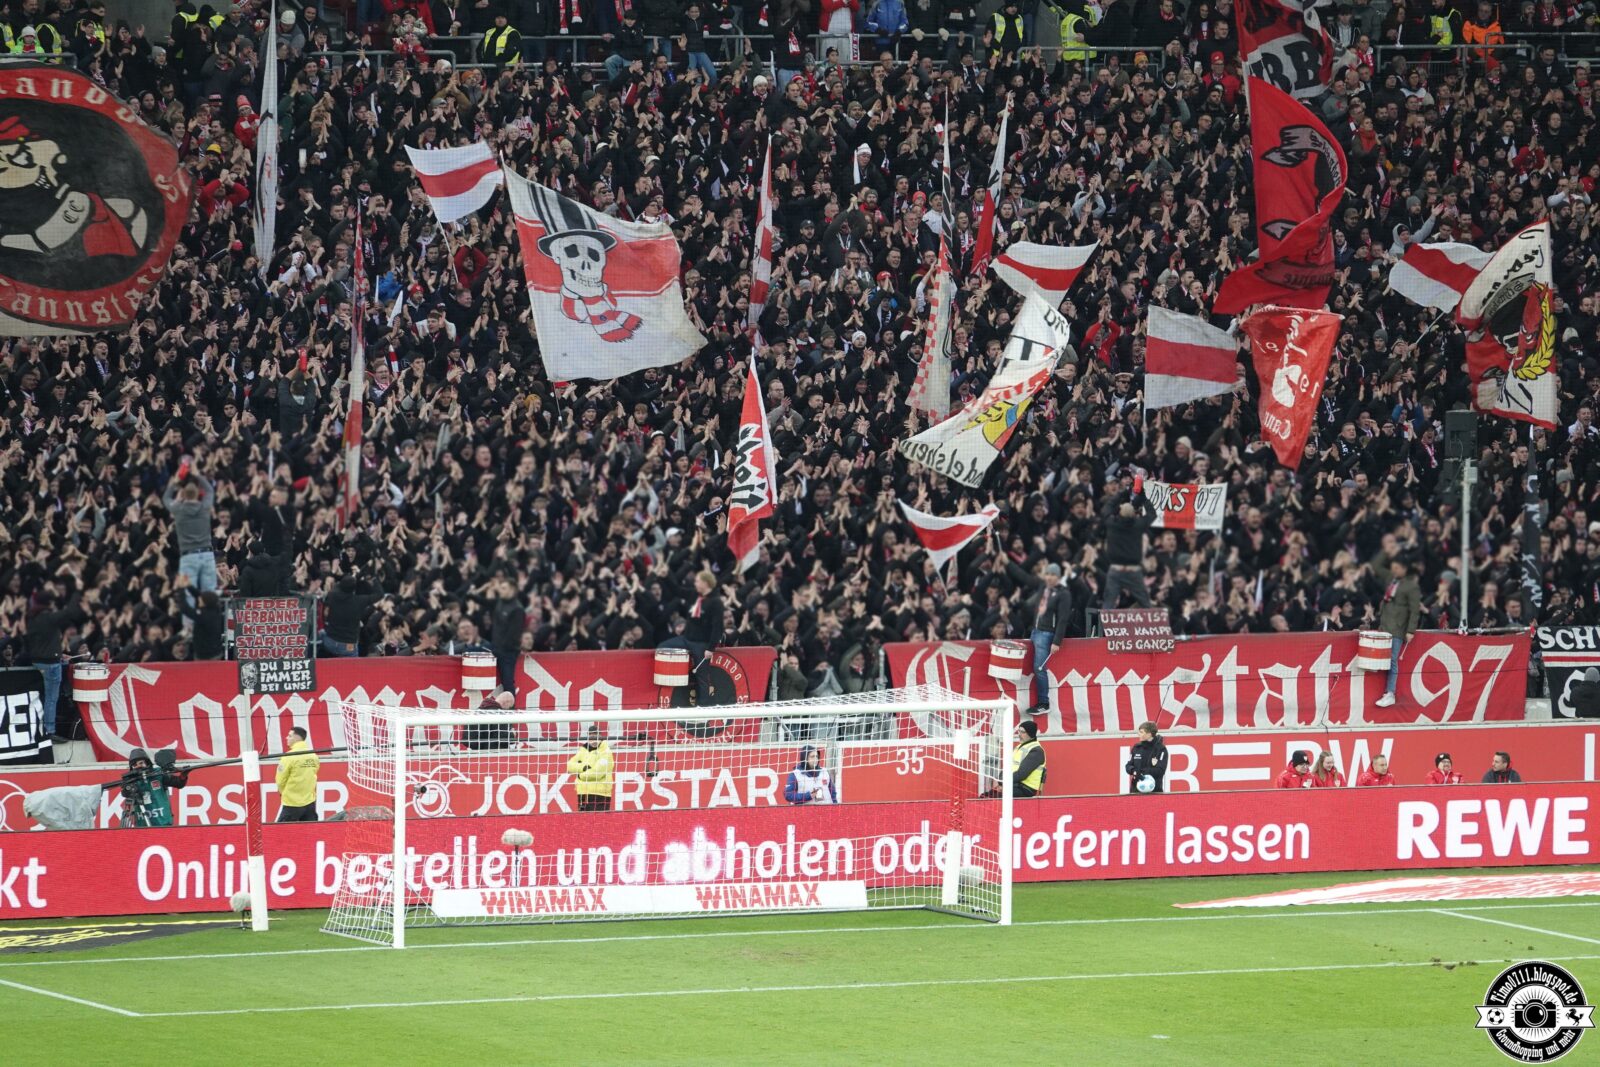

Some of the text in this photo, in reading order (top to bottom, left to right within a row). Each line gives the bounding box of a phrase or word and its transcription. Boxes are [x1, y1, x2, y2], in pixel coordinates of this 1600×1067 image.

[1194, 486, 1223, 516] 07
[245, 598, 299, 609] JEDER
[236, 608, 307, 623] VERBANNTE
[1100, 612, 1143, 623] ULTRA
[242, 623, 301, 635] KEHRT
[1104, 627, 1129, 637] DER
[1537, 626, 1600, 650] SCH
[1107, 640, 1132, 651] UMS
[260, 660, 310, 671] DU BIST
[260, 670, 311, 682] IMMER
[1410, 641, 1513, 724] 97
[261, 681, 312, 691] BEI UNS!
[895, 747, 925, 776] 35
[471, 767, 780, 817] JOKRSTAR
[315, 836, 537, 895] bestellen
[557, 828, 647, 886] und
[662, 824, 854, 882] abholen
[999, 814, 1146, 870] iefern
[1165, 811, 1310, 865] lassen
[1397, 796, 1590, 860] REWE
[480, 882, 822, 916] WINAMAX WINAMAX
